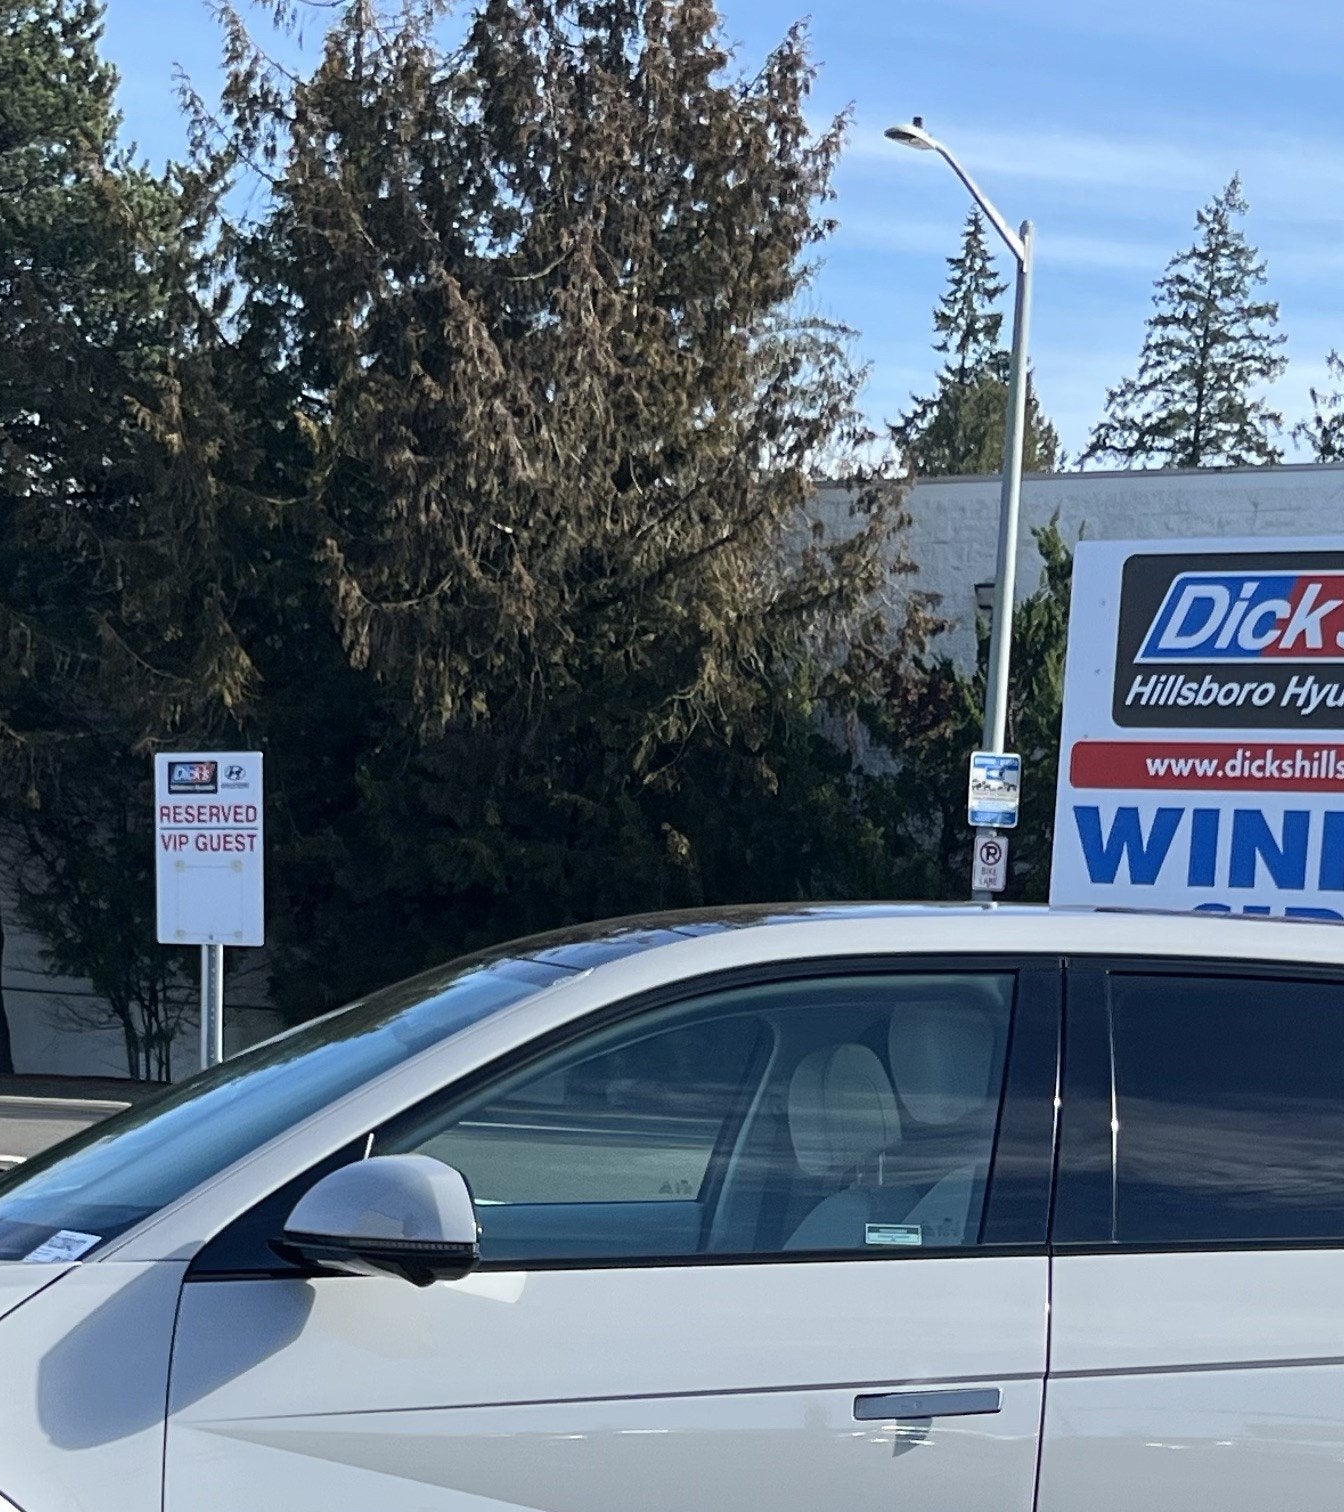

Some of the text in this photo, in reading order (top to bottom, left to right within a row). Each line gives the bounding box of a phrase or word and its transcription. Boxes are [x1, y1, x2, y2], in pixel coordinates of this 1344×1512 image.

[1124, 674, 1276, 707] Hillsboro
[160, 805, 257, 824] RESERVED
[161, 833, 257, 852] VIP GUEST
